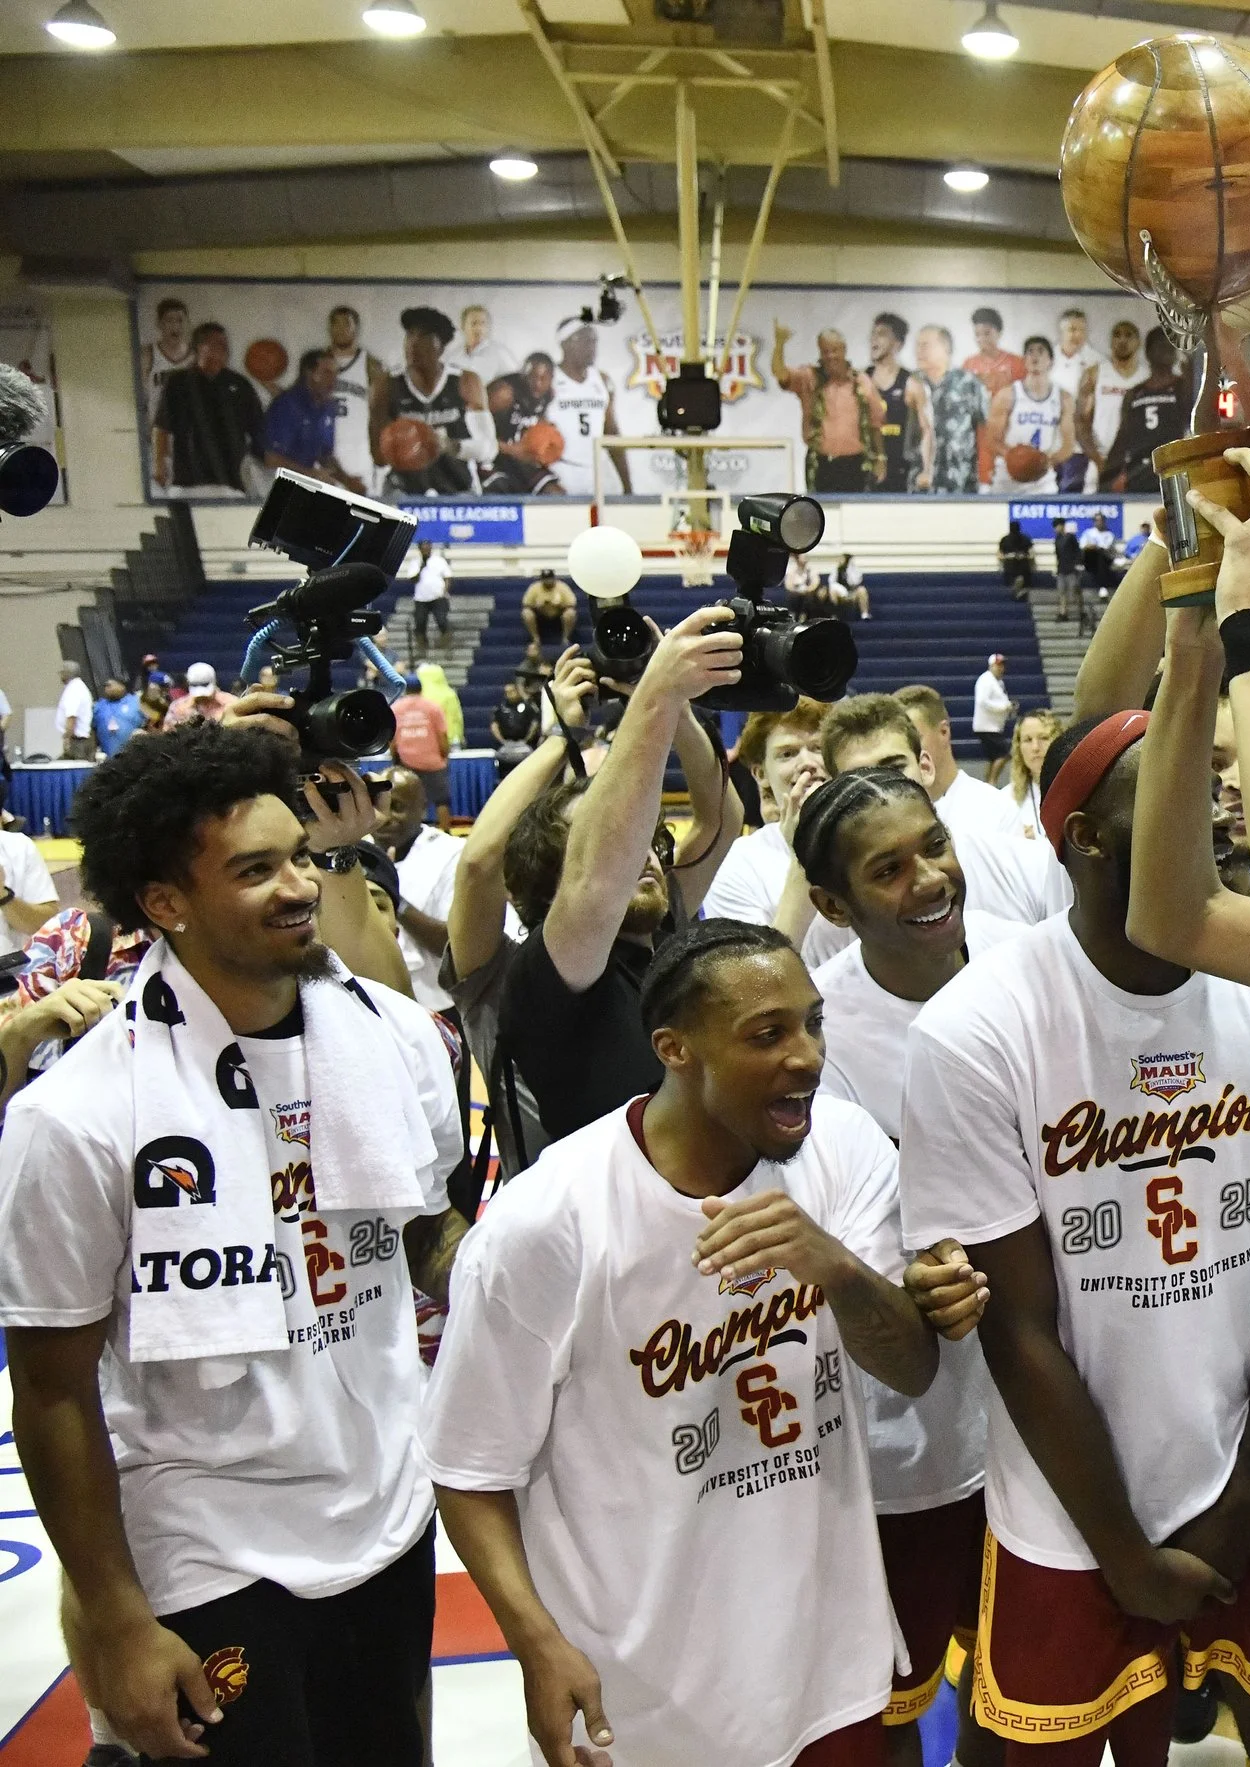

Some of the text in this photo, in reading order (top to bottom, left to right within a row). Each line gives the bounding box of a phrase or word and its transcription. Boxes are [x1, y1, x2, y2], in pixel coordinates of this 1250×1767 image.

[579, 412, 591, 437] 5
[1018, 410, 1061, 426] UCLA
[1144, 405, 1160, 430] 5
[1029, 428, 1042, 449] 4
[439, 506, 519, 521] BLEACHERS
[1012, 504, 1119, 519] EAST BLEACHERS
[756, 605, 776, 614] Nikon
[1138, 1050, 1191, 1065] Southwest
[1139, 1061, 1197, 1082] MAUI
[275, 1100, 311, 1113] Southw
[278, 1112, 310, 1129] MA
[1061, 1199, 1122, 1255] 20
[1146, 1175, 1198, 1266] SC
[350, 1216, 399, 1268] 25
[1079, 1274, 1168, 1292] UNIVERSITY
[1171, 1272, 1186, 1288] OF
[1131, 1282, 1214, 1309] CALIFORNIA
[671, 1406, 720, 1476] 20
[735, 1362, 802, 1449] SC
[773, 1452, 790, 1470] OF
[736, 1460, 821, 1499] CALIFORNIA
